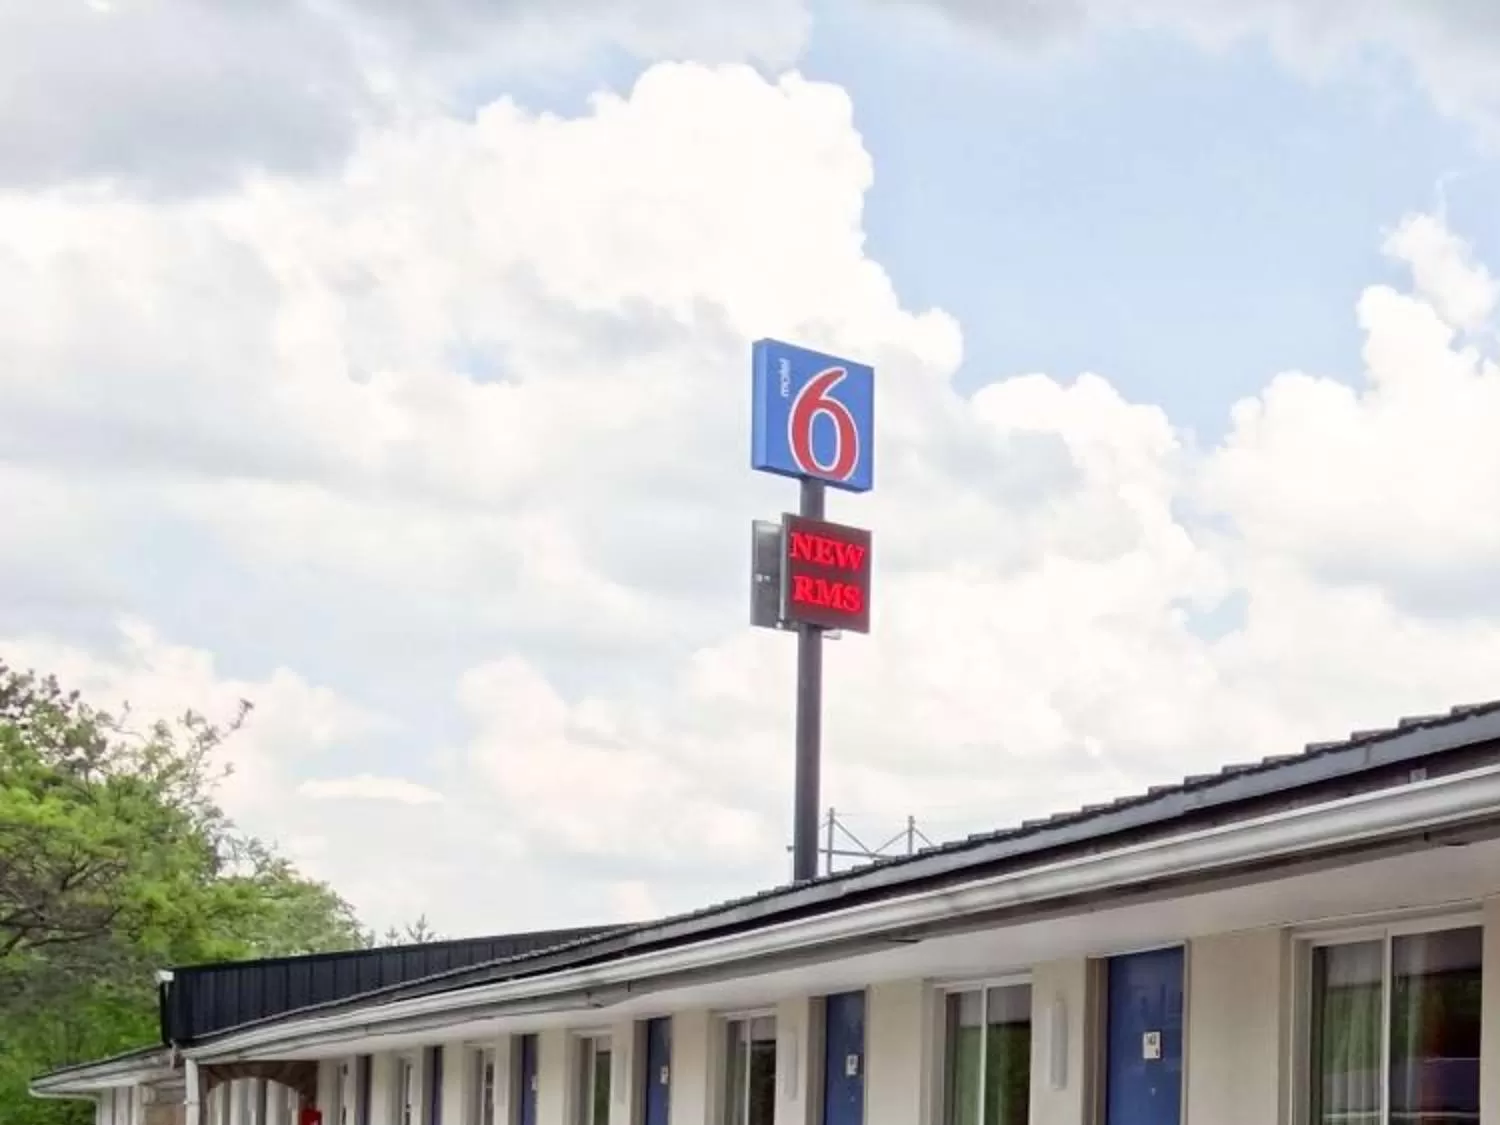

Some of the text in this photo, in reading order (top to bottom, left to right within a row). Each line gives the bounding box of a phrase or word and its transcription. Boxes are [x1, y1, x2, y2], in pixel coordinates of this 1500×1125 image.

[788, 367, 859, 481] 6
[790, 532, 865, 570] NEW
[793, 575, 862, 612] RMS
